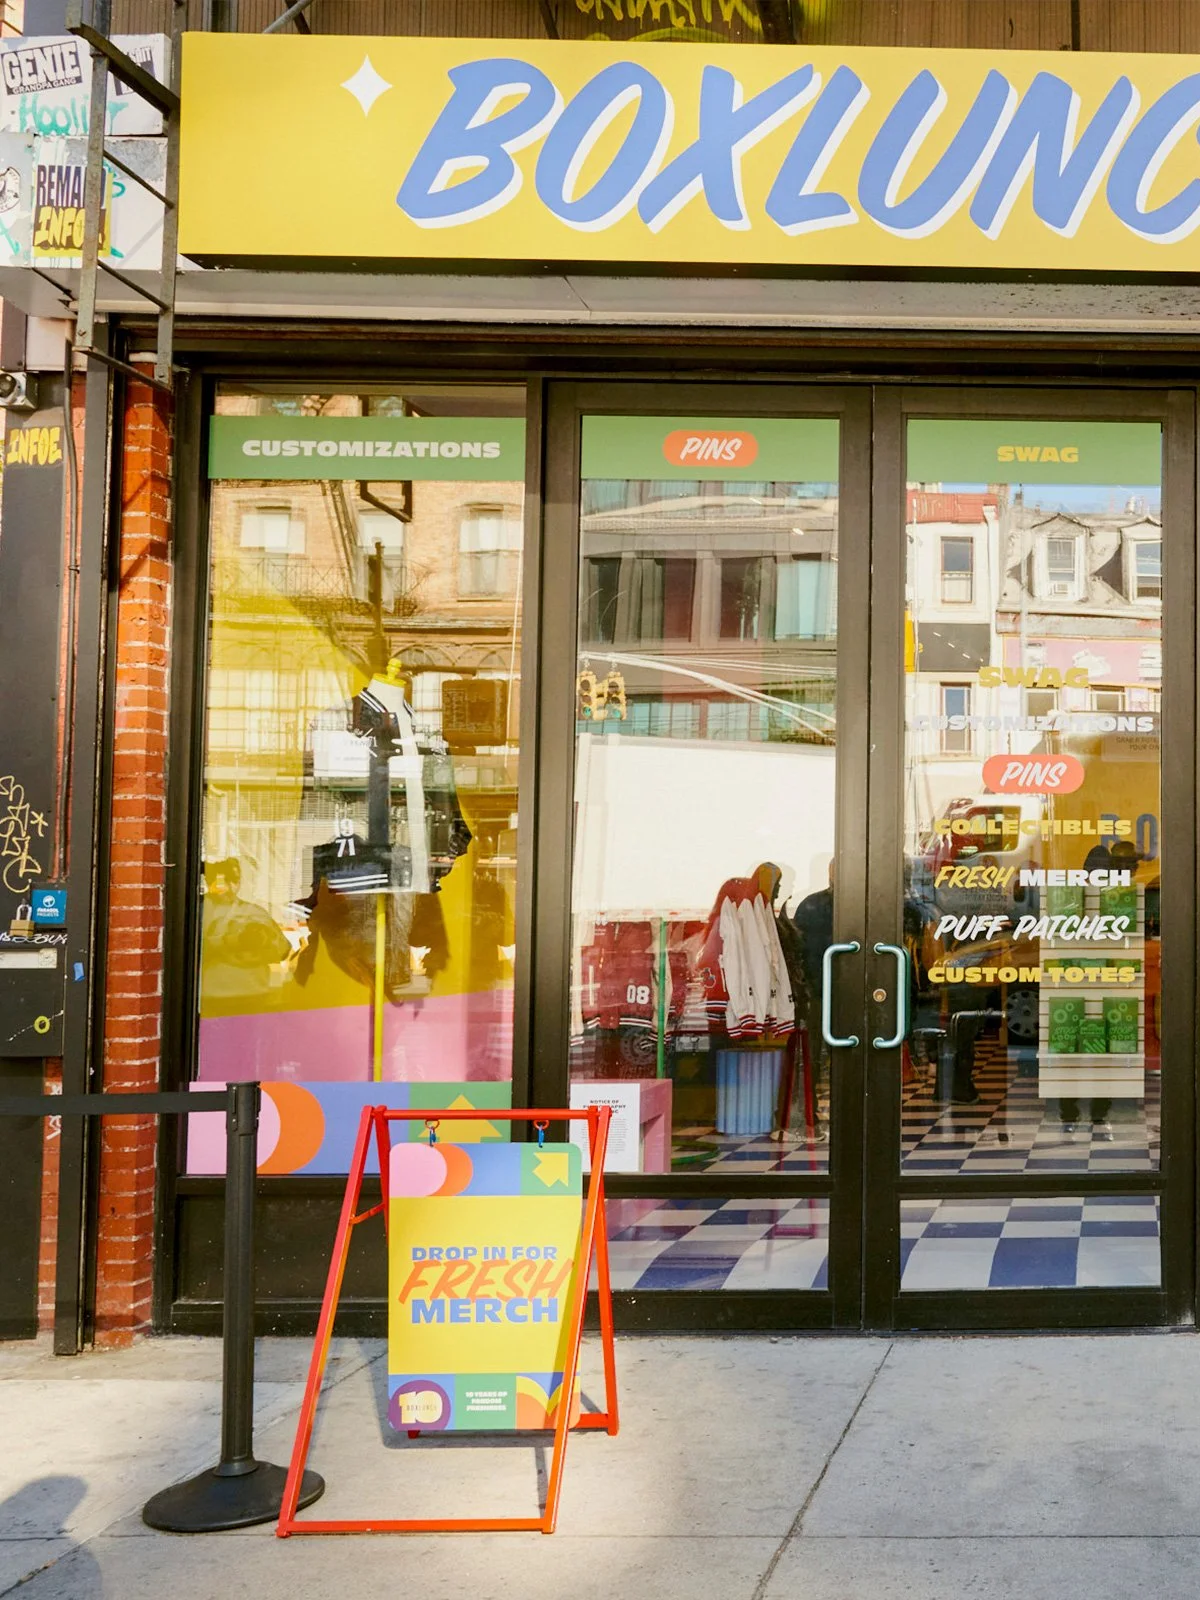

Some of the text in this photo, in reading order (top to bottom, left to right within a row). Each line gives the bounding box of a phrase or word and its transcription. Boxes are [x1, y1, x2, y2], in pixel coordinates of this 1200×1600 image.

[2, 44, 80, 88] GENIE
[12, 78, 77, 94] GRANDPA GANG
[7, 426, 62, 466] INFOE
[242, 439, 500, 459] CUSTOMIZATIONS
[679, 437, 743, 461] PINS
[997, 445, 1079, 463] SWAG
[979, 667, 1089, 688] SWAG
[913, 715, 1154, 733] CUSTOMIZATIONS
[1000, 761, 1067, 788] PINS
[934, 819, 1132, 836] COLLECTIBLES
[335, 838, 356, 857] 71
[934, 865, 1131, 889] FRESH MERCH
[933, 915, 1130, 941] PUFF PATCHES
[927, 966, 1136, 983] CUSTOM TOTES
[627, 984, 650, 1004] 08
[411, 1246, 558, 1261] DROP IN FOR
[398, 1258, 575, 1305] FRESH
[411, 1298, 558, 1323] MERCH
[399, 1390, 443, 1424] 10
